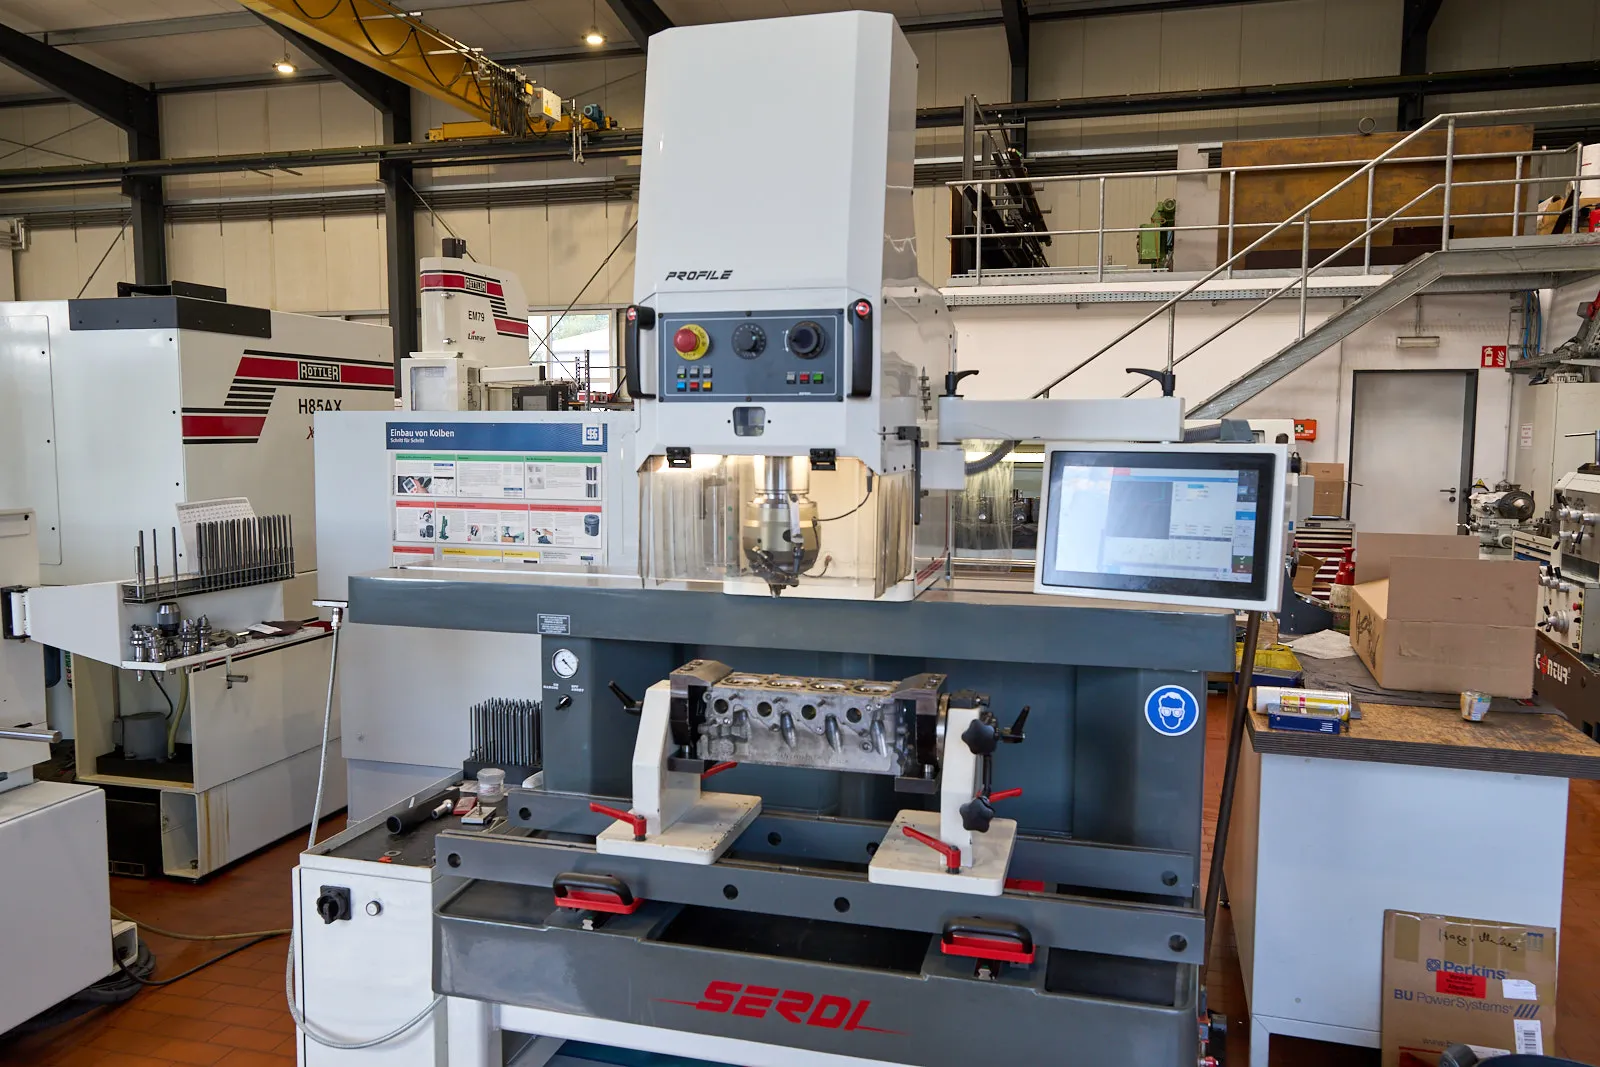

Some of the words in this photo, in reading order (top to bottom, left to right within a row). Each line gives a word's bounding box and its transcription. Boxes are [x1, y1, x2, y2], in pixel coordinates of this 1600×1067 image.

[665, 270, 733, 281] PROFILE
[468, 310, 485, 322] EM79
[467, 330, 486, 342] Linear
[301, 363, 339, 381] ROTTLER
[298, 398, 342, 415] H85AX
[390, 428, 414, 437] Einbau
[429, 428, 455, 438] Kolben
[1443, 960, 1506, 980] Perkins
[1394, 988, 1414, 1001] BU
[696, 980, 871, 1031] SERDI
